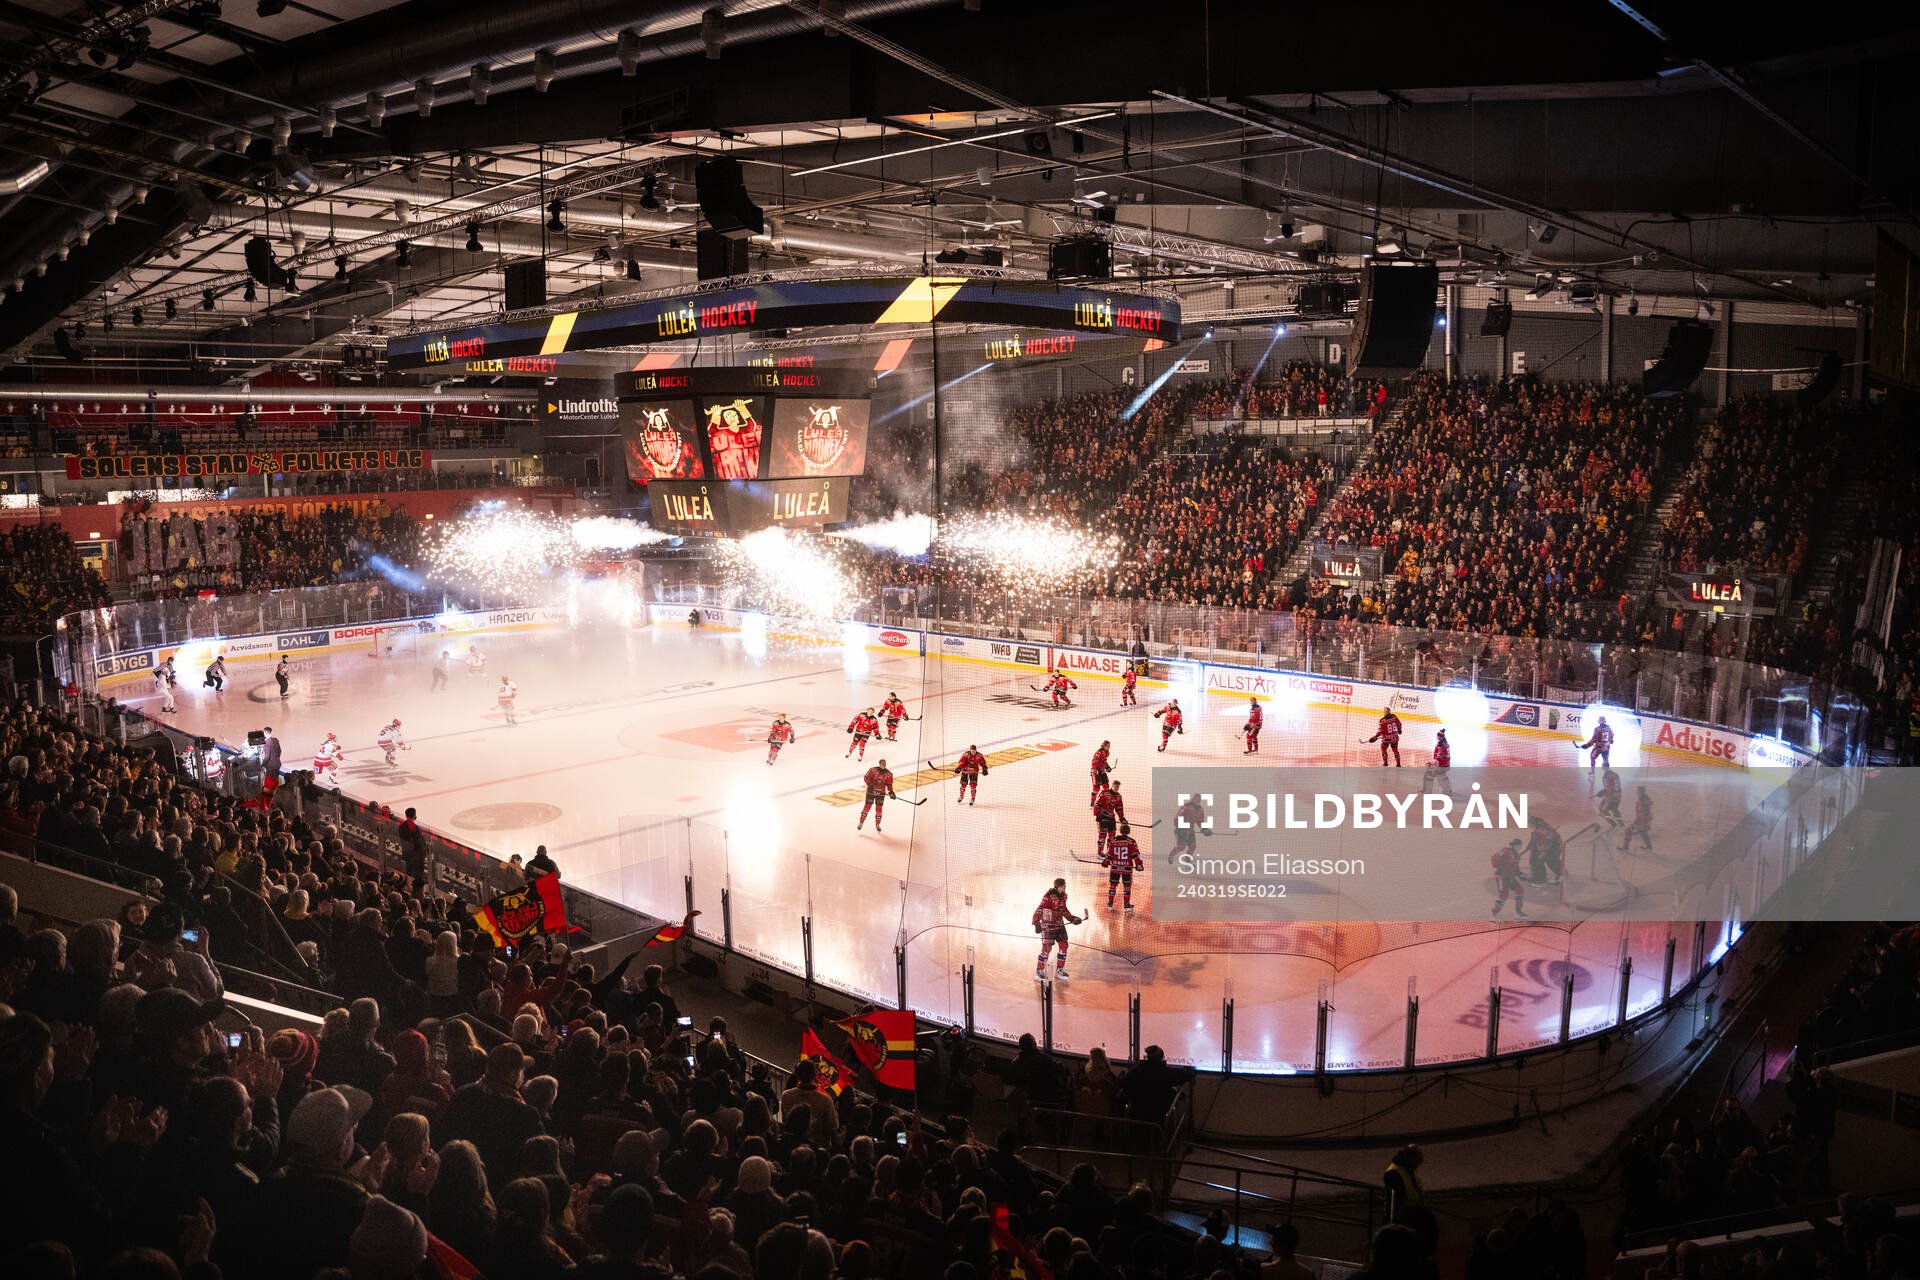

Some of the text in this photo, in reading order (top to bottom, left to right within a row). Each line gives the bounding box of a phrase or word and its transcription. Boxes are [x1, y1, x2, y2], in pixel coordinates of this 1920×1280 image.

[657, 300, 757, 336] LULEÅ HOCKEY
[1074, 298, 1161, 331] LULEÅ HOCKEY
[424, 336, 485, 362] LULEÅ HOCKEY
[985, 334, 1075, 360] LULEÅ HOCKEY
[1329, 344, 1341, 364] D
[508, 357, 556, 372] HOCKEY
[1512, 351, 1525, 374] E
[635, 373, 657, 390] LULEÅ
[1122, 367, 1134, 385] C
[559, 399, 618, 413] Lindroths
[80, 450, 422, 479] SOLENS STAD FOLKETS LAG
[664, 486, 714, 520] LULEÅ
[773, 482, 830, 520] LULEÅ
[1324, 558, 1360, 576] LULEÅ
[1692, 579, 1742, 601] LULEÅ
[281, 636, 315, 647] DAHL
[1311, 681, 1352, 694] KVANTUM
[1655, 722, 1738, 761] Advise
[1113, 847, 1128, 860] 42
